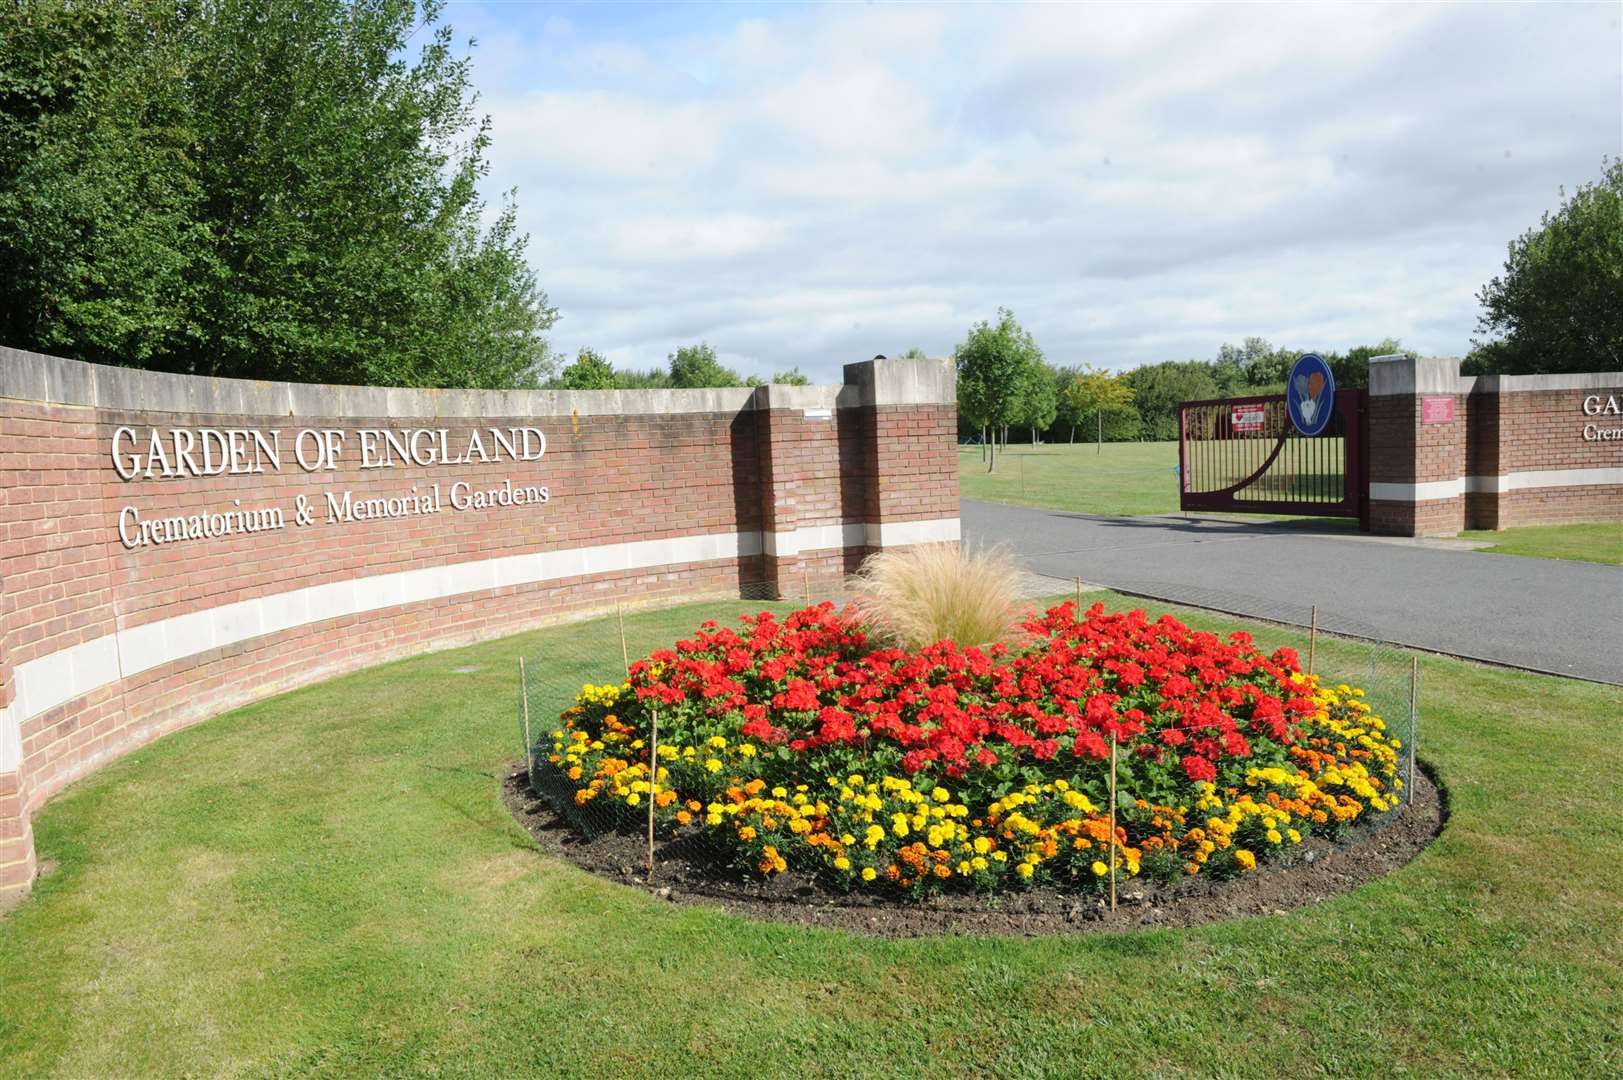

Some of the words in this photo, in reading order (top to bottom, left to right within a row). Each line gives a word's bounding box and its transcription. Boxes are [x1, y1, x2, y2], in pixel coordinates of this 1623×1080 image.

[1583, 395, 1623, 415] GA
[111, 426, 281, 481] GARDEN
[295, 428, 345, 472] OF
[360, 426, 547, 470] ENGLAND
[118, 499, 284, 549] Crematorium
[294, 494, 315, 527] &
[325, 484, 441, 524] Memorial
[450, 478, 550, 511] Gardens
